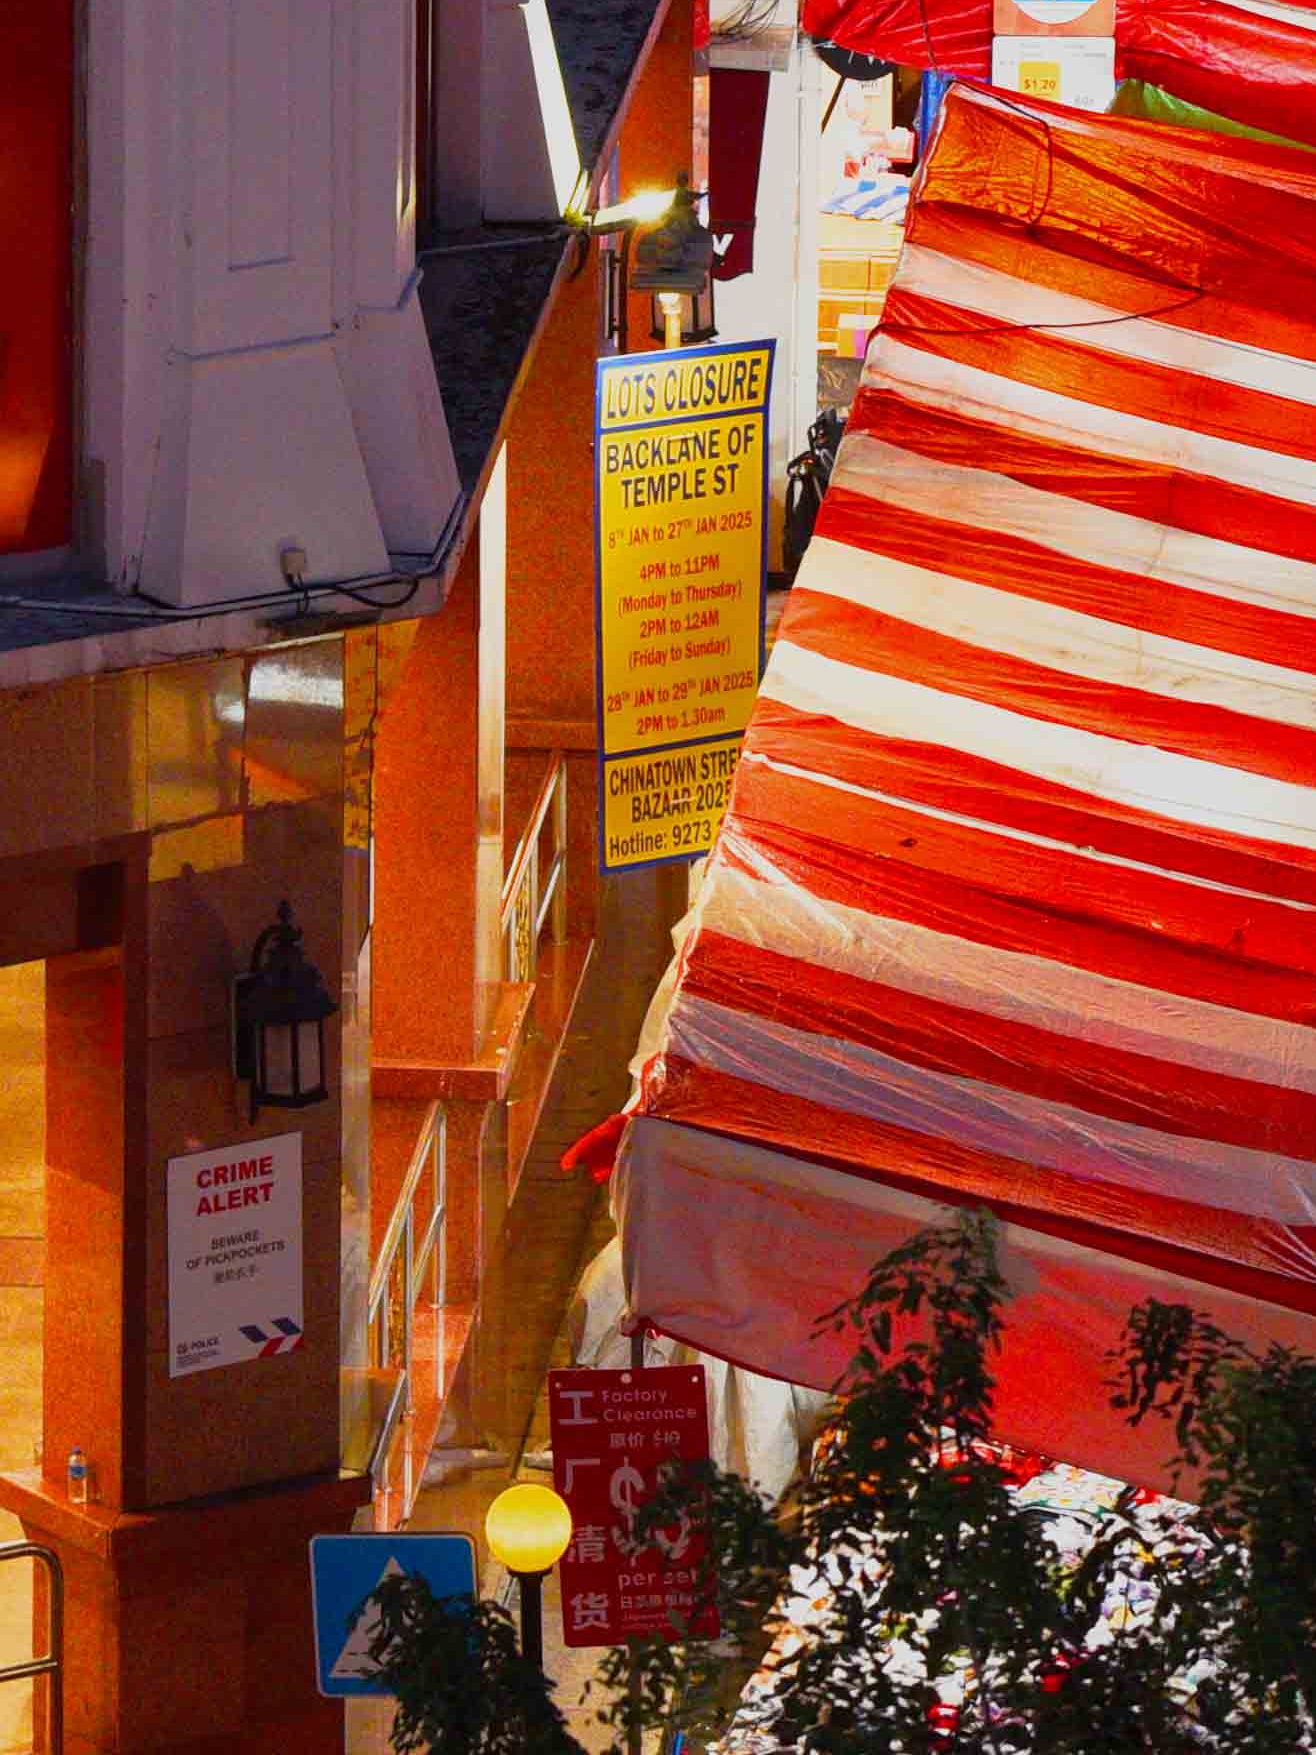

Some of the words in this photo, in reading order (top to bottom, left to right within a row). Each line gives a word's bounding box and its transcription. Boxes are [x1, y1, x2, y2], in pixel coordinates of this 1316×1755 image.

[607, 373, 656, 419] LOTS
[664, 358, 762, 412] CLOSURE
[606, 429, 721, 474] BACKLANE
[728, 424, 755, 455] OF
[621, 468, 707, 509] TEMPLE
[713, 463, 739, 495] ST
[628, 522, 649, 547] JAN
[653, 524, 665, 541] to
[696, 514, 717, 535] JAN
[720, 511, 753, 531] 2025
[639, 562, 666, 581] 4PM
[670, 562, 681, 577] to
[685, 554, 720, 575] 11PM
[617, 592, 667, 617] (Monday
[671, 589, 683, 602] to
[686, 579, 743, 604] Thursday)
[639, 619, 666, 640] 2PM
[670, 617, 681, 632] to
[685, 610, 720, 631] 12AM
[628, 649, 667, 671] (Friday
[671, 645, 682, 661] to
[686, 638, 731, 660] Sunday)
[634, 688, 655, 707] JAN
[658, 688, 670, 702] to
[698, 677, 720, 697] JAN
[723, 671, 754, 691] 2025
[636, 717, 664, 736] 2PM
[666, 714, 679, 730] to
[681, 706, 726, 728] 1.30am
[609, 755, 697, 796] CHINATOWN
[631, 788, 691, 823] BAZAAR
[609, 832, 667, 859] Hotline:
[672, 819, 712, 846] 9273
[196, 1155, 274, 1189] CRIME
[196, 1182, 275, 1216] ALERT
[210, 1229, 261, 1251] BEWARE
[602, 1390, 668, 1404] Factory
[602, 1407, 698, 1422] Clearance
[617, 1572, 656, 1590] per
